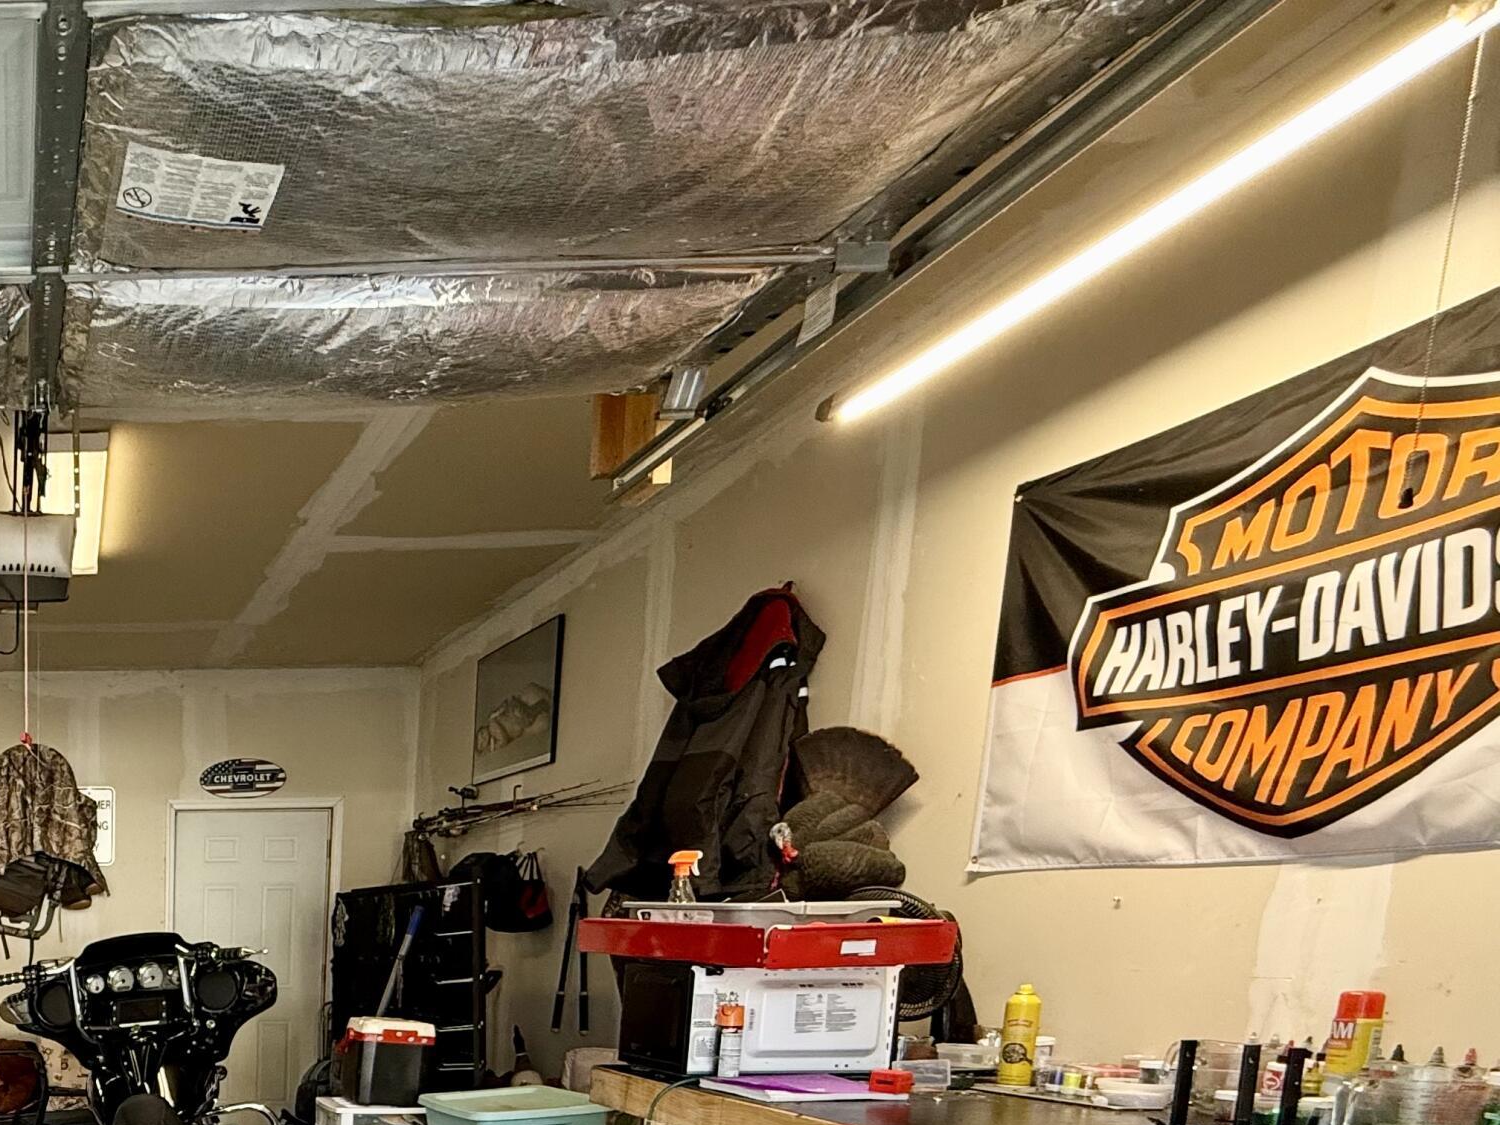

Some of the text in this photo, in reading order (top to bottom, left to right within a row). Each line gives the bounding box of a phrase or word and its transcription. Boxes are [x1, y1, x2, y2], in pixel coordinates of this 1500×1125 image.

[1211, 429, 1500, 570] MOTOR
[1093, 528, 1500, 697] HARLEY-DAVID
[213, 773, 272, 783] CHEVROLET
[1170, 662, 1483, 805] COMPANY
